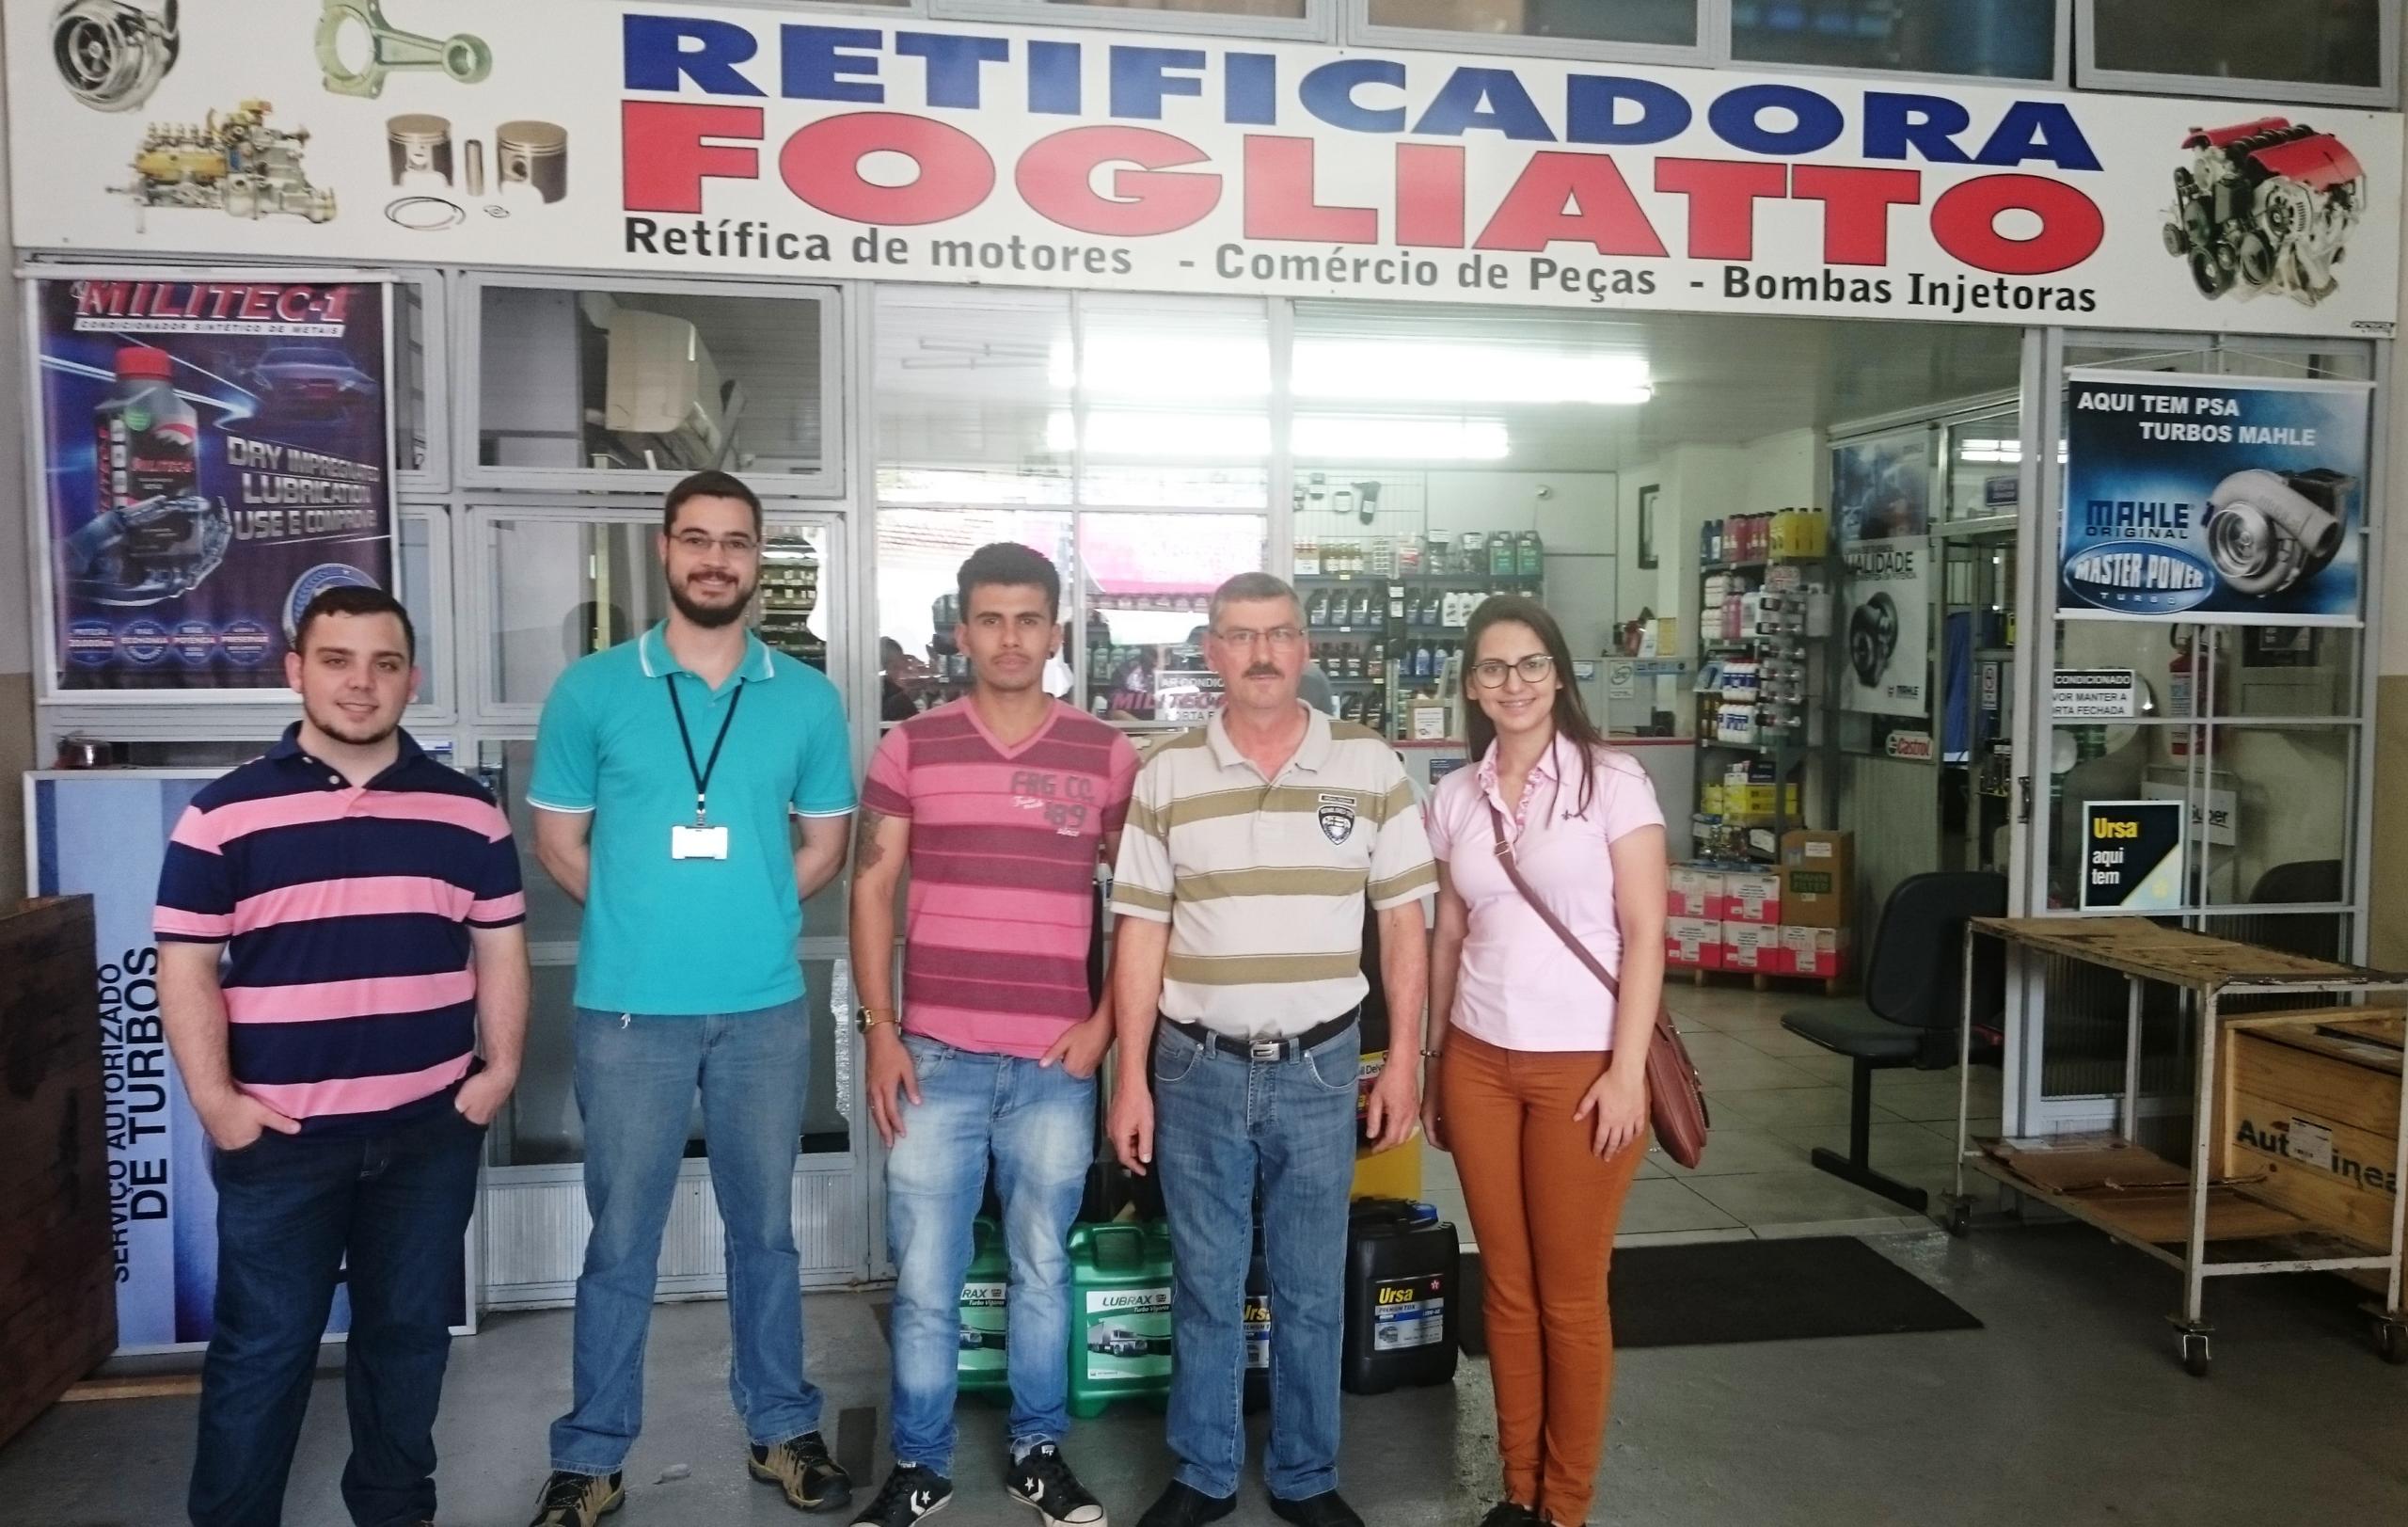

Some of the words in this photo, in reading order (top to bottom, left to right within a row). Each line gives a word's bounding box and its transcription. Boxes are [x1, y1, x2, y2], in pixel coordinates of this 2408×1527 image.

[623, 12, 2104, 171] RETIFICADORA
[621, 99, 2104, 276] FOGLIATTO
[625, 217, 831, 262] Retífica
[852, 228, 909, 264] de
[930, 238, 1133, 274] motores
[1216, 244, 1438, 286] Comércio
[1459, 254, 1508, 290] de
[1530, 257, 1656, 302] Peças
[1724, 265, 1892, 304] Bombas
[1909, 272, 2096, 313] Injetoras
[75, 279, 349, 322] MILITEC-1
[293, 326, 339, 336] METAIS
[2077, 391, 2134, 412] AQUI
[2141, 394, 2189, 415] TEM
[2195, 397, 2241, 417] PSA
[2139, 422, 2232, 442] TURBOS
[2238, 426, 2316, 446] MAHLE
[227, 436, 282, 470] DRY
[242, 472, 372, 504] LUBRICATION
[233, 510, 283, 541] USE
[288, 510, 301, 535] E
[2085, 500, 2190, 529] MAHLE
[2085, 526, 2189, 539] ORIGINAL
[2074, 552, 2143, 588] MASTER
[2146, 553, 2204, 590] POWER
[2099, 592, 2177, 605] TURBO
[2054, 676, 2131, 685] CONDICIONADO
[2052, 692, 2073, 702] VOR
[2076, 692, 2118, 702] MANTER
[2120, 693, 2128, 702] A
[2077, 706, 2125, 715] FECHADA
[2093, 817, 2138, 838] Ursa
[2092, 847, 2124, 865] aqui
[2091, 867, 2119, 884] tem
[98, 962, 126, 1151] AUTORIZADO
[122, 945, 166, 1145] TURBOS
[130, 1157, 167, 1221] DE
[105, 1158, 134, 1283] SERVIÇO
[962, 1288, 988, 1298] RAX
[1102, 1295, 1152, 1307] LUBRAX
[1379, 1287, 1414, 1304] Ursa
